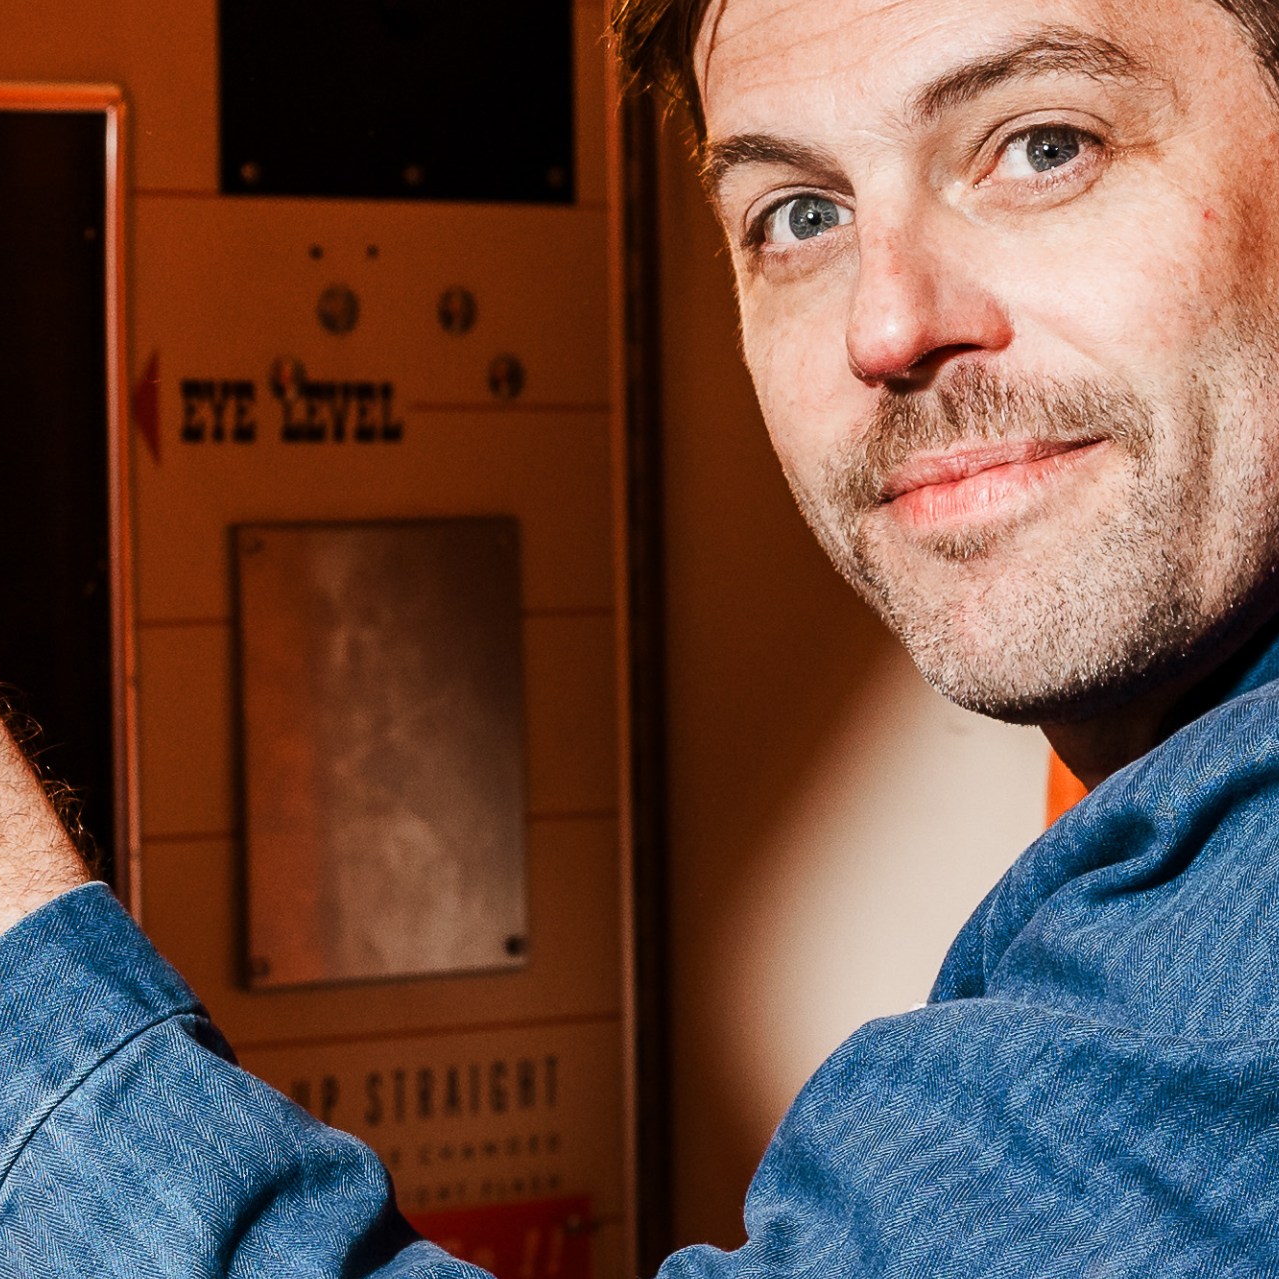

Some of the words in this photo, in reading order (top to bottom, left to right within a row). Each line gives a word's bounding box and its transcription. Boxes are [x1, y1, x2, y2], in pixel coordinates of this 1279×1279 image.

[181, 379, 256, 443] EYE
[281, 379, 404, 443] LEVEL
[363, 1054, 558, 1126] STRAIGHT
